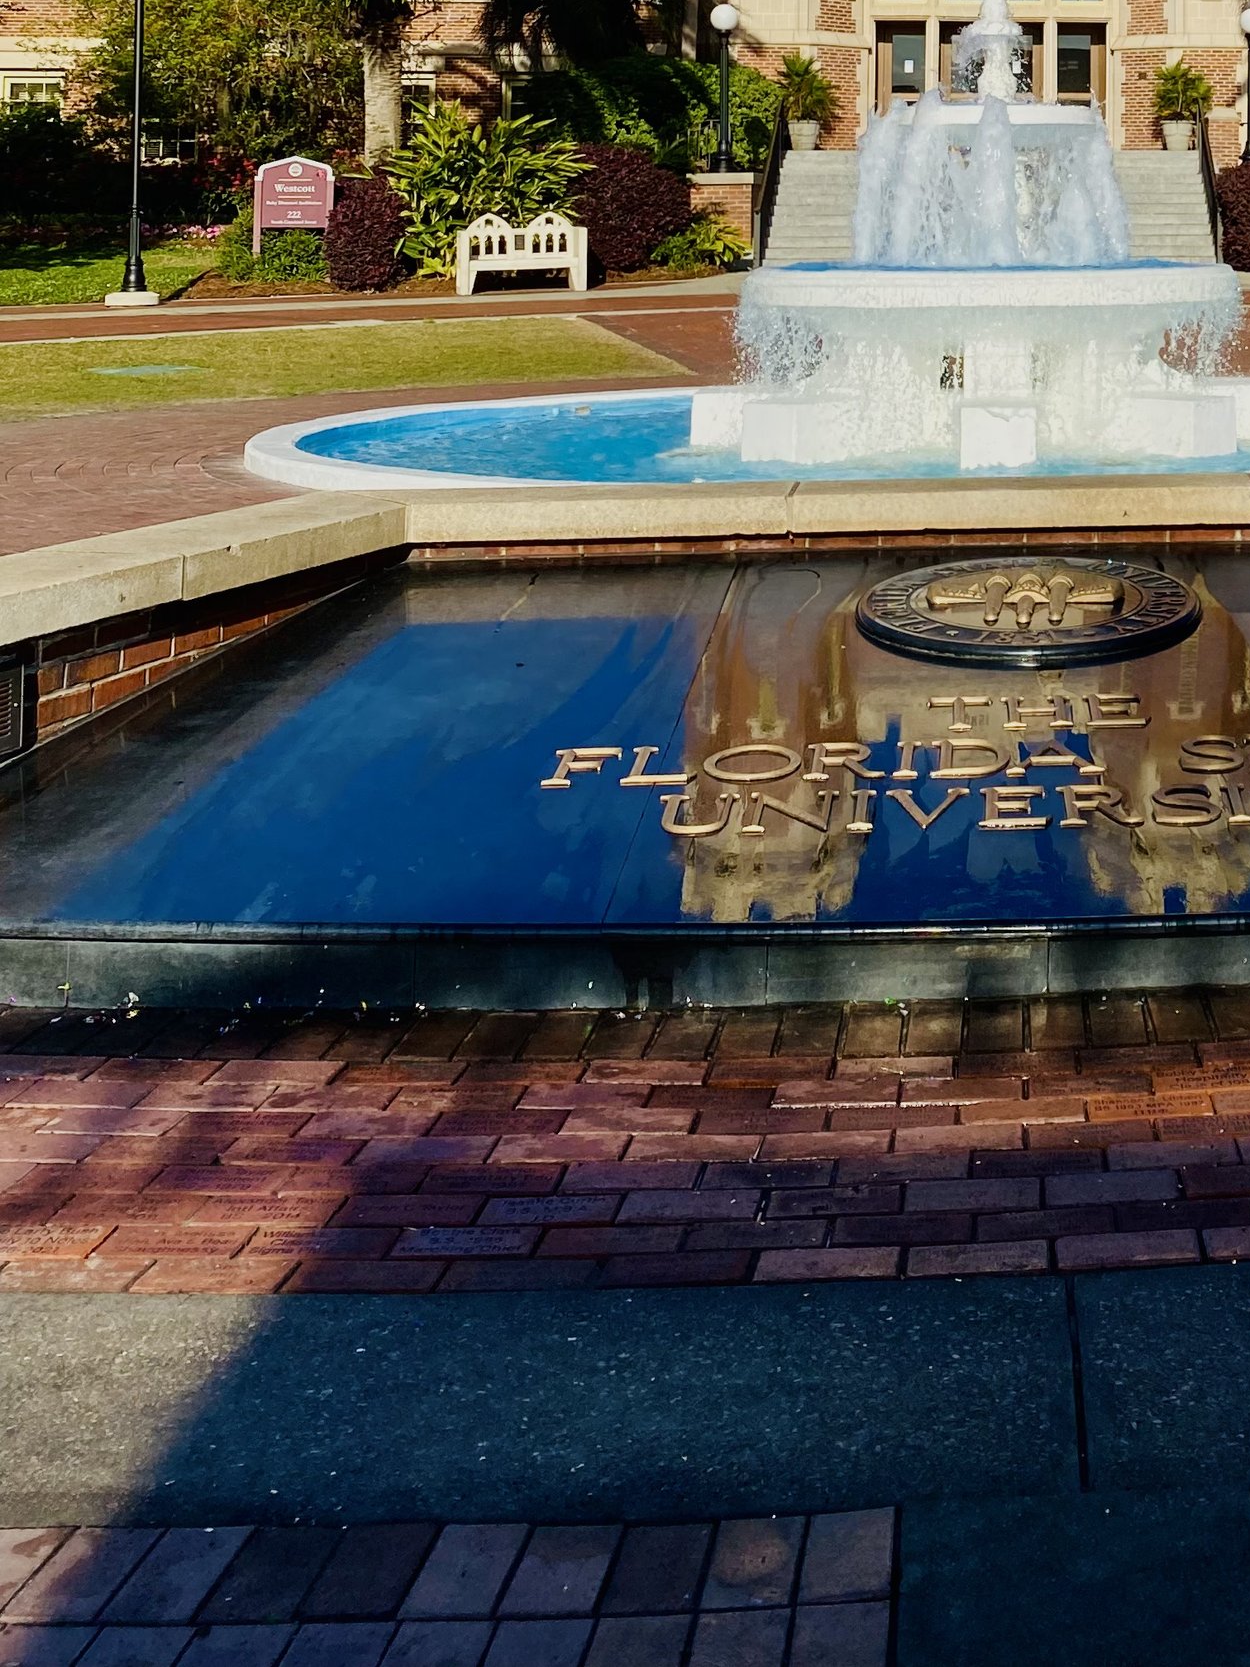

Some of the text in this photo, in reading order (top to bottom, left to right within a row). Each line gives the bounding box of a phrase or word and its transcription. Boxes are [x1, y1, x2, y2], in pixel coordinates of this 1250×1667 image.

[274, 183, 315, 193] Westcott
[286, 210, 301, 219] 222
[926, 692, 1152, 732] THE
[540, 737, 1107, 790] FLORIDA
